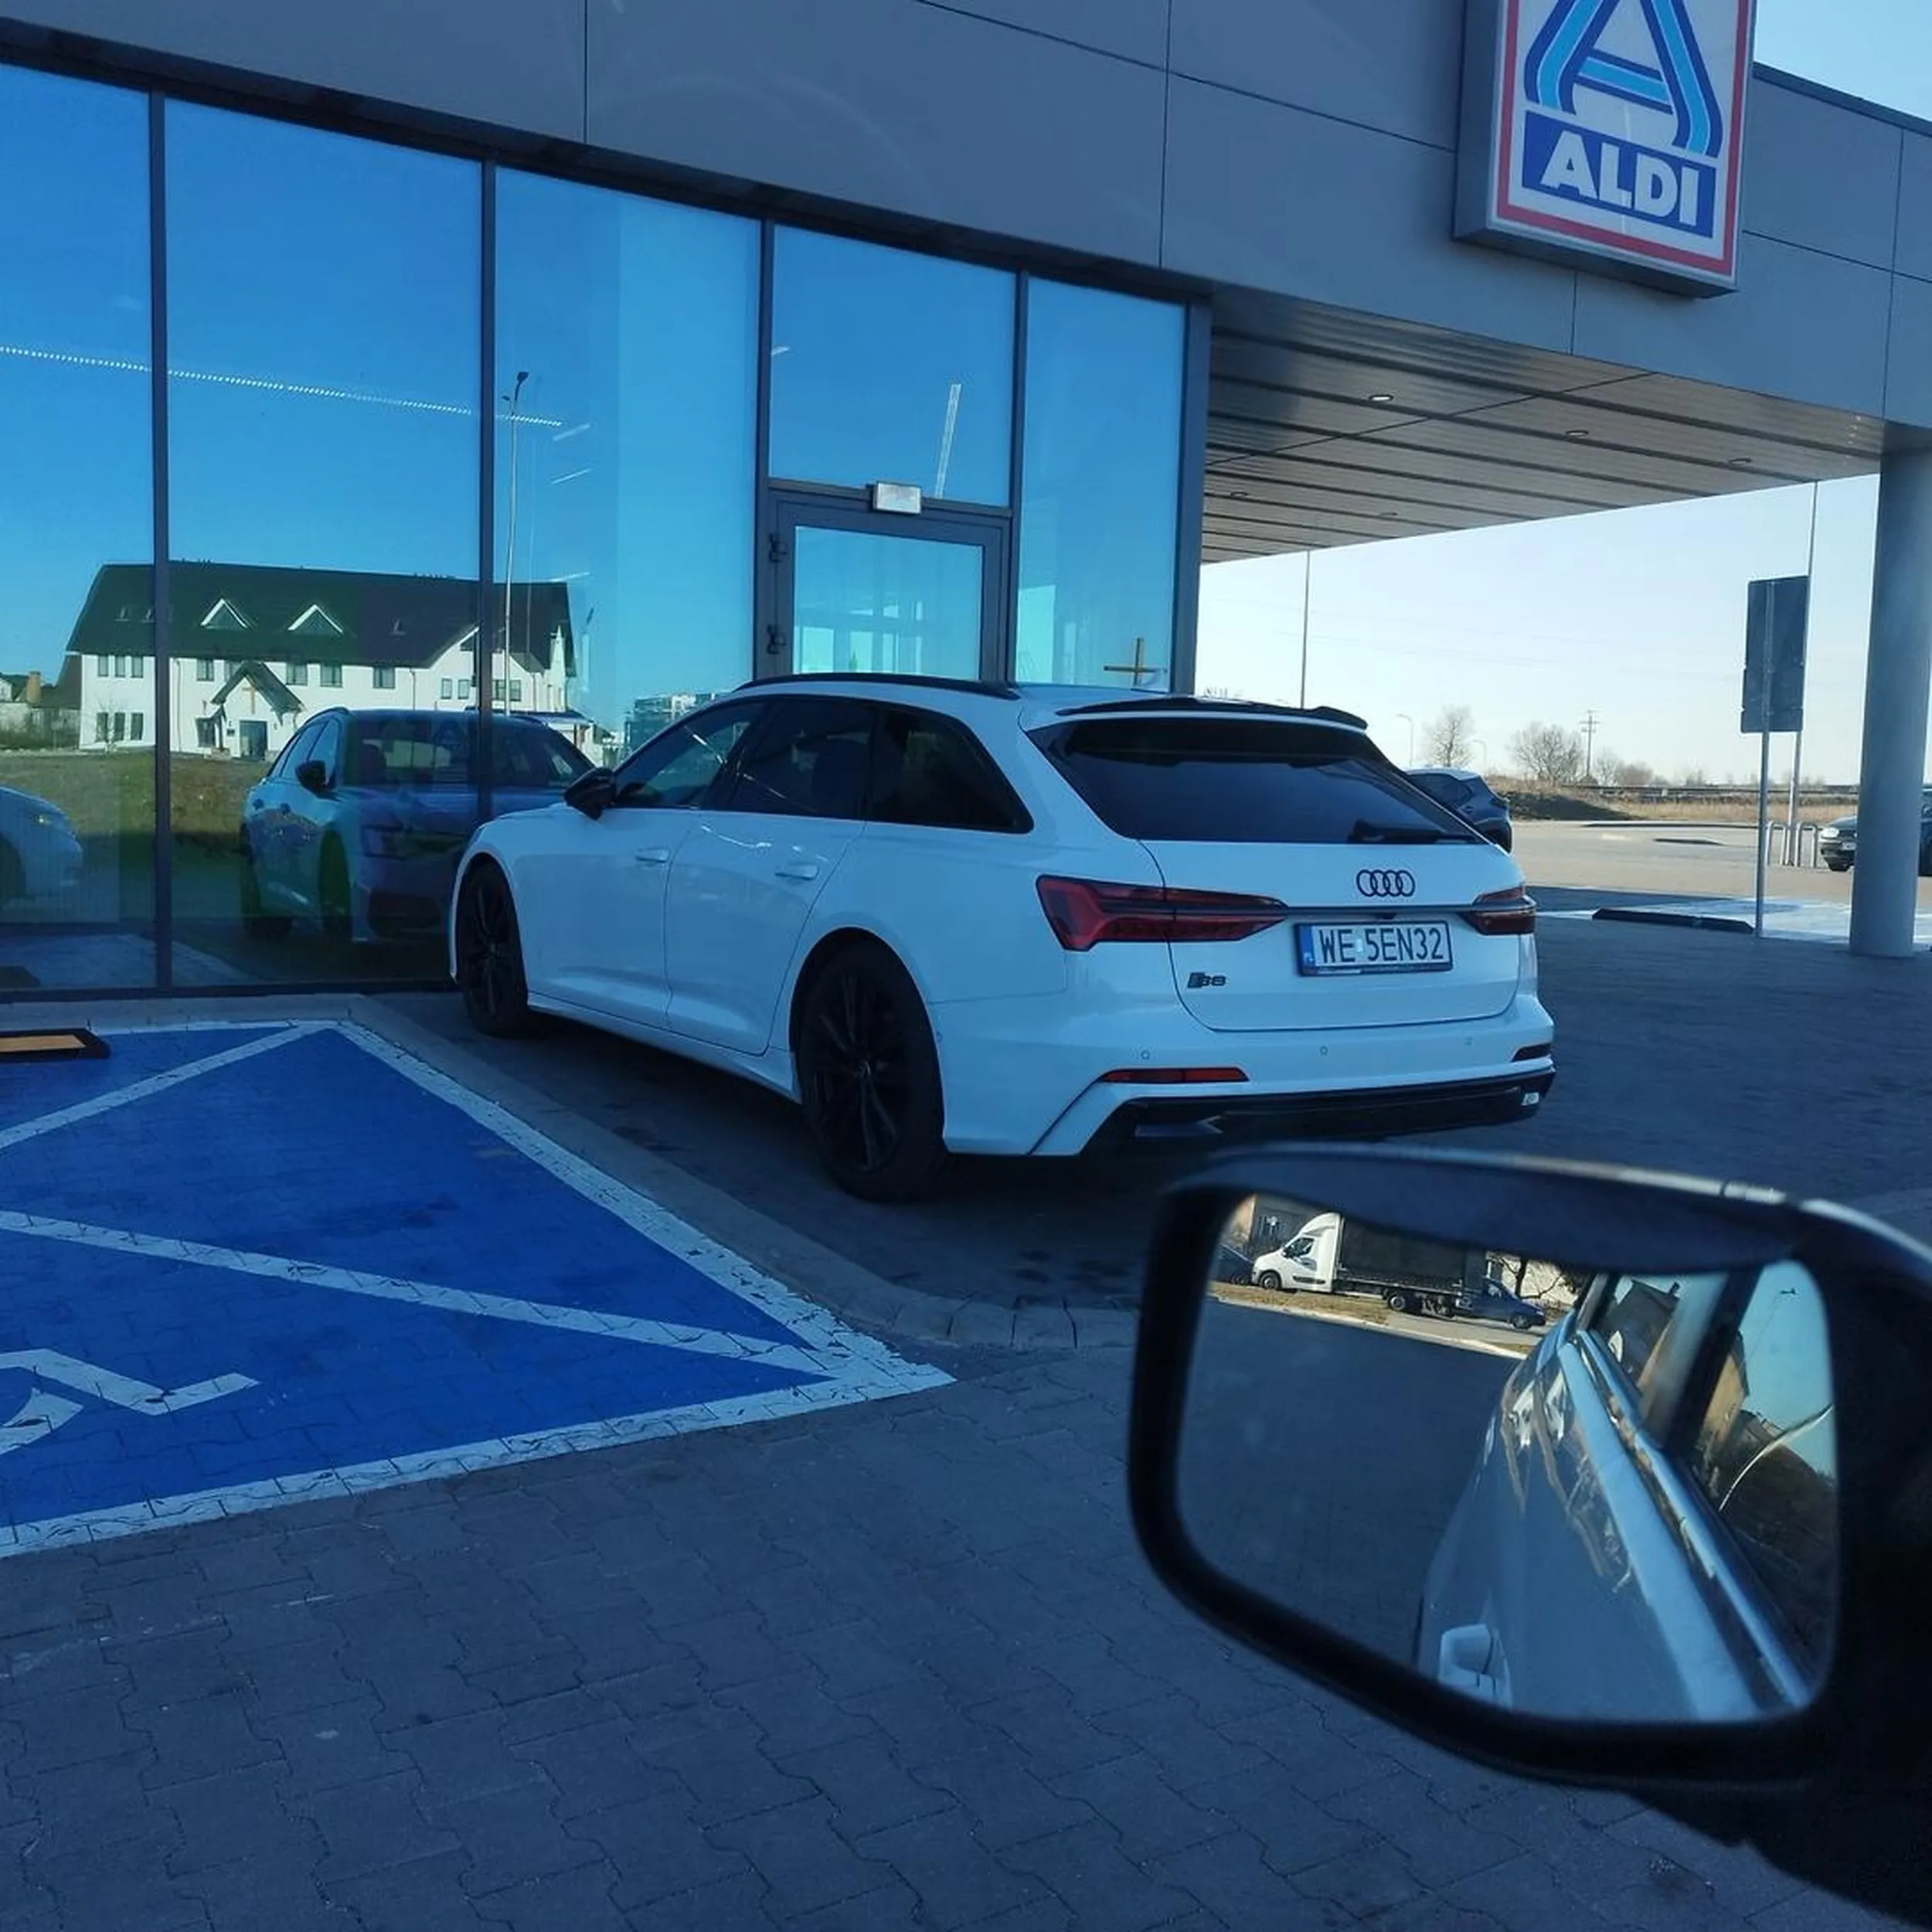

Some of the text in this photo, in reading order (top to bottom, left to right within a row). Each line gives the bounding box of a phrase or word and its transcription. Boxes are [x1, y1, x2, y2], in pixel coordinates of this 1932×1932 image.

[1539, 130, 1700, 226] ALDI
[1318, 929, 1355, 964] WE
[1365, 927, 1444, 961] 5EN32
